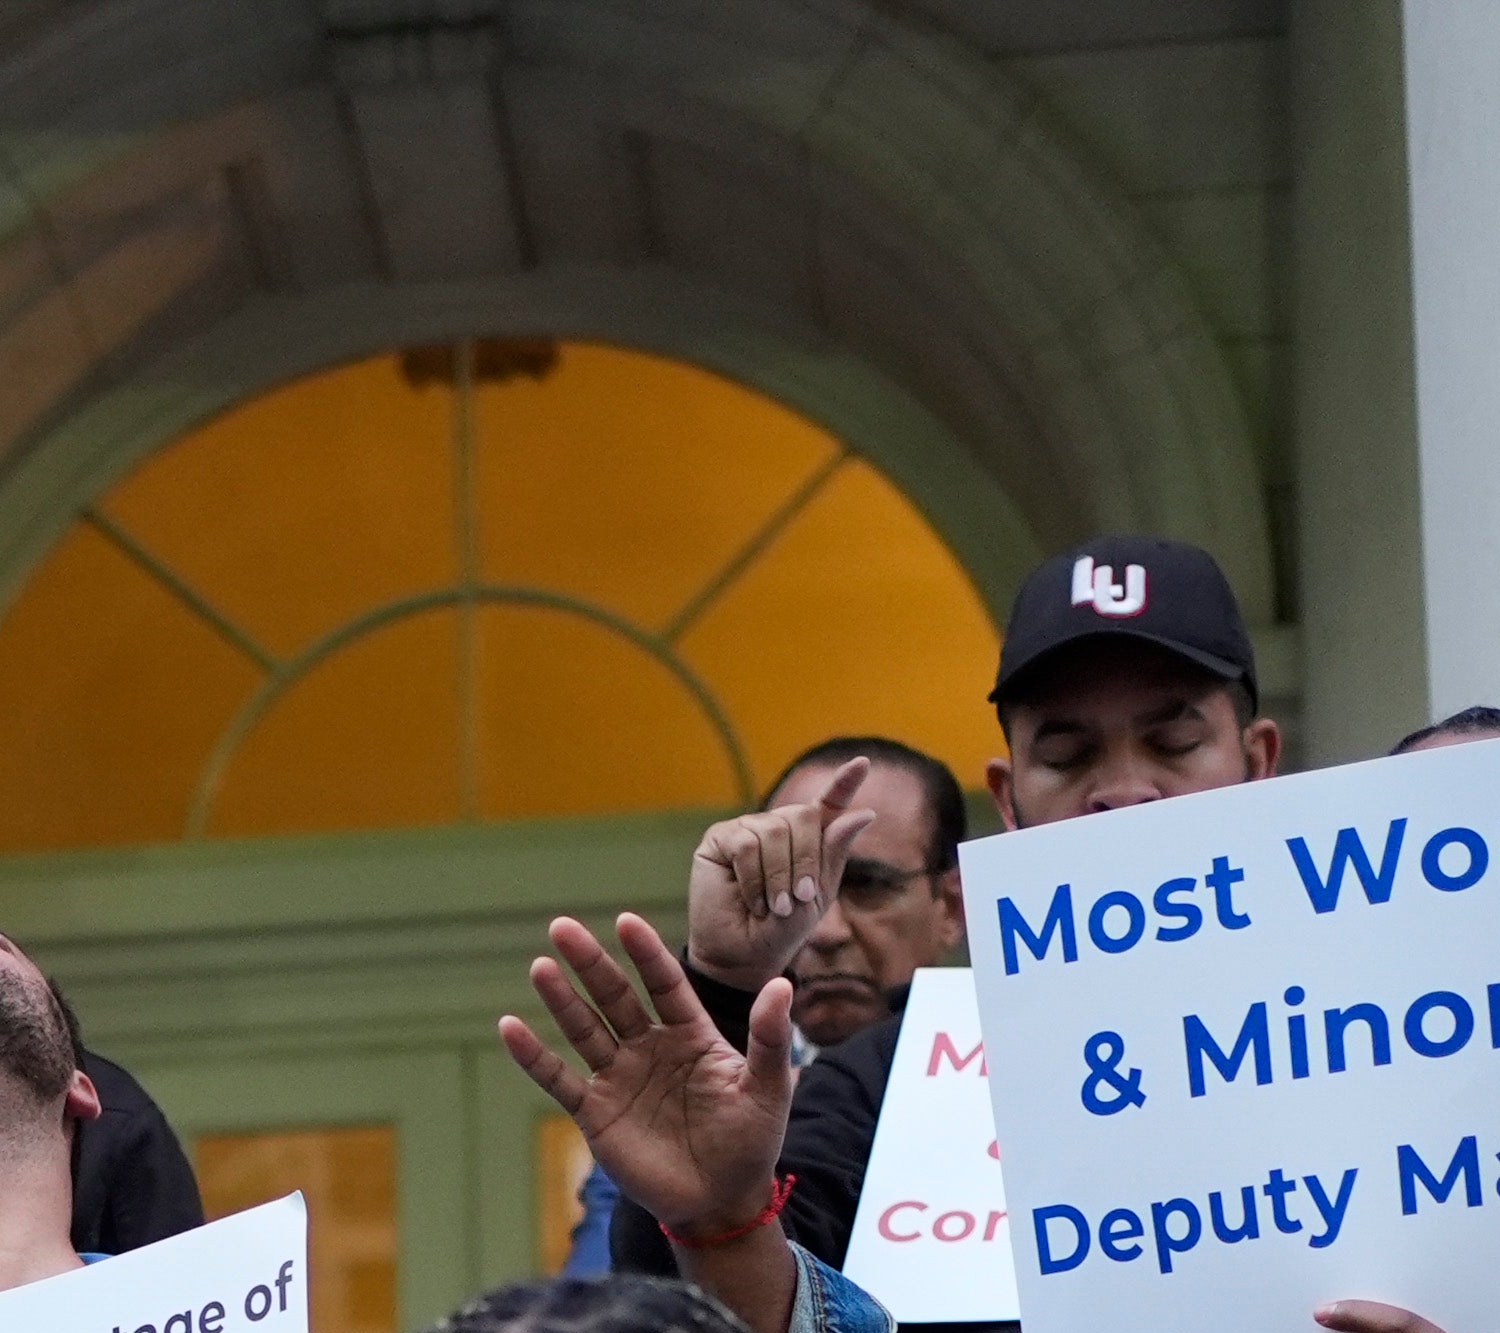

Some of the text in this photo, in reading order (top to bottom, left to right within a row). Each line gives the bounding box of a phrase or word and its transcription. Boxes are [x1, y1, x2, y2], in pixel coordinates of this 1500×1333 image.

[997, 856, 1251, 976] Most
[1081, 1031, 1147, 1116] &
[1032, 1168, 1358, 1275] Deputy
[245, 1260, 293, 1321] of
